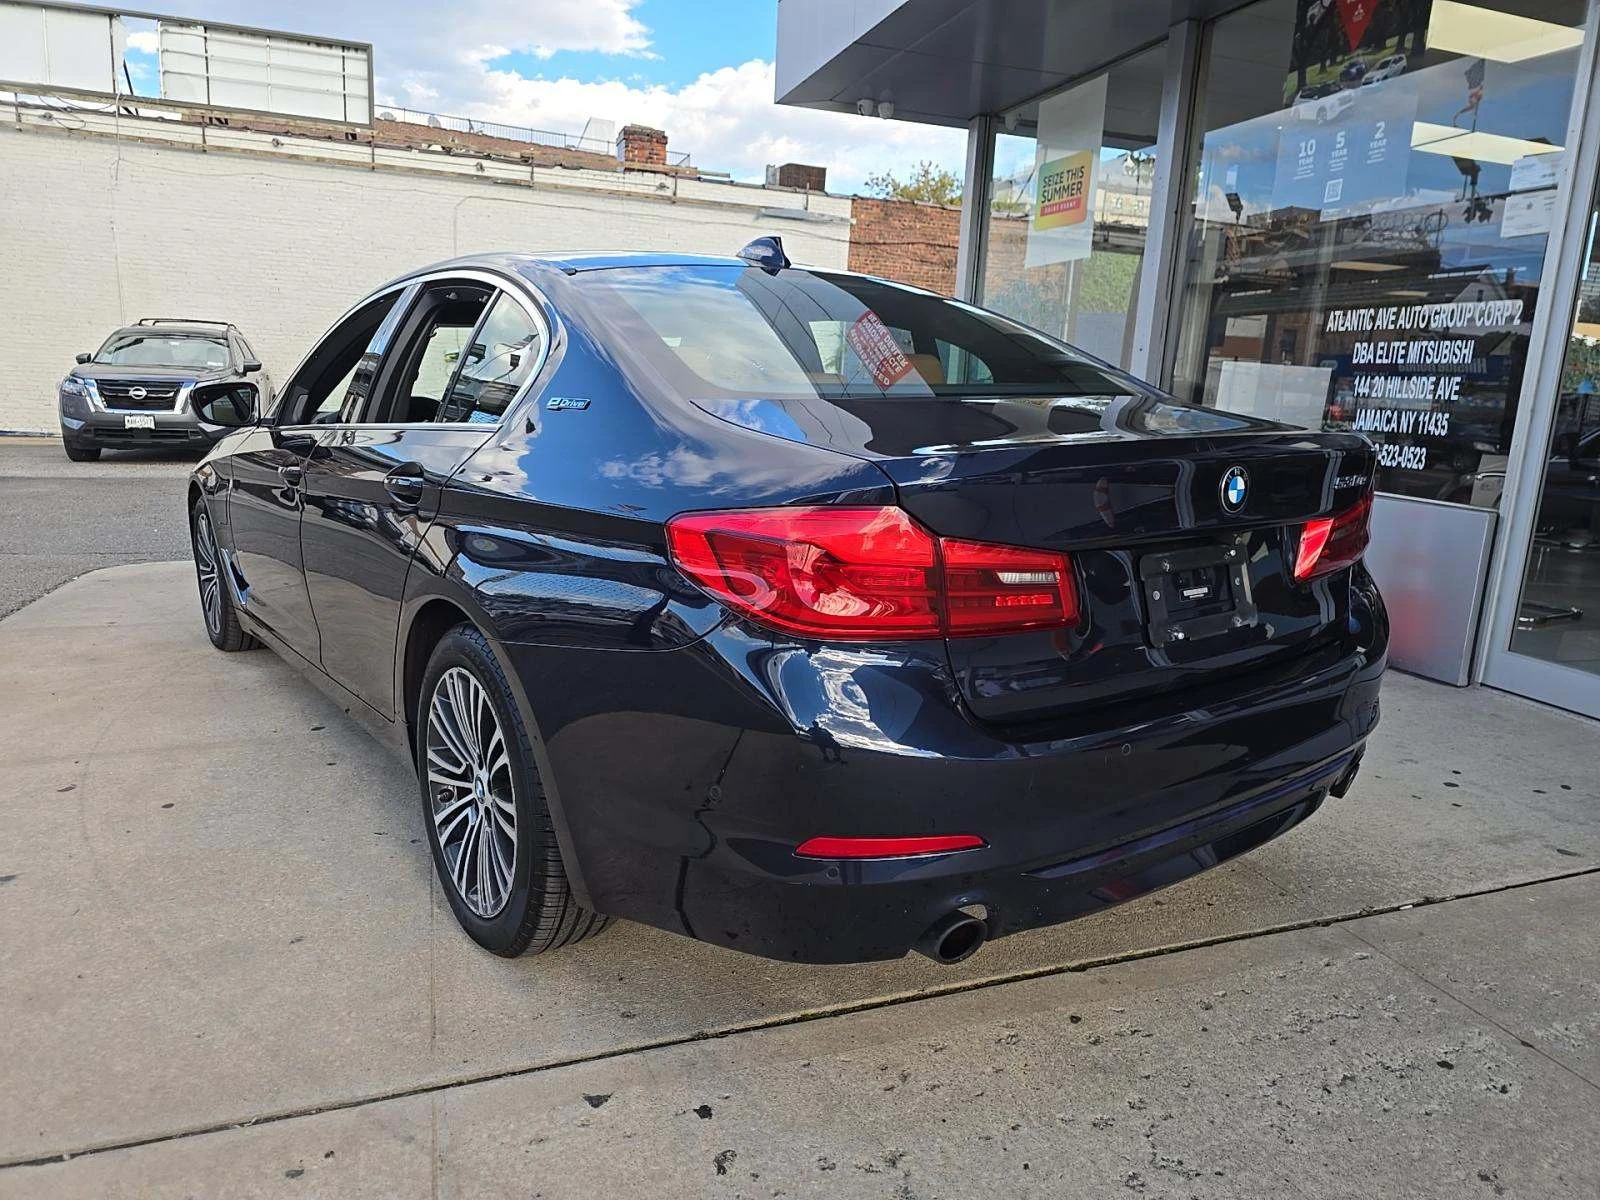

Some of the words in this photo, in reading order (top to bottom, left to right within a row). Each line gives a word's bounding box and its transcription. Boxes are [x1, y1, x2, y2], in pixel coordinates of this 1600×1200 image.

[1336, 131, 1345, 149] 5
[1374, 121, 1385, 139] 2
[1299, 139, 1316, 157] 10
[1043, 171, 1064, 188] SEIZE
[1066, 166, 1084, 182] THIS
[1041, 181, 1082, 203] SUMMER
[1326, 308, 1374, 332] ATLANTIC
[1374, 307, 1398, 330] AVE
[1397, 304, 1430, 329] AUTO
[1430, 302, 1474, 328] GROUP
[1475, 300, 1512, 327] CORP
[1512, 299, 1524, 326] 2
[1353, 342, 1374, 364] DBA
[1376, 341, 1406, 364] ELITE
[1407, 340, 1475, 364] MITSUBISHI
[1354, 375, 1370, 398] 144
[1371, 376, 1384, 398] 20
[1385, 376, 1435, 400] HILLSIDE
[1435, 376, 1461, 400] AVE
[1352, 408, 1397, 433] JAMAICA
[1400, 410, 1418, 434] NY
[1418, 412, 1449, 436] 11435
